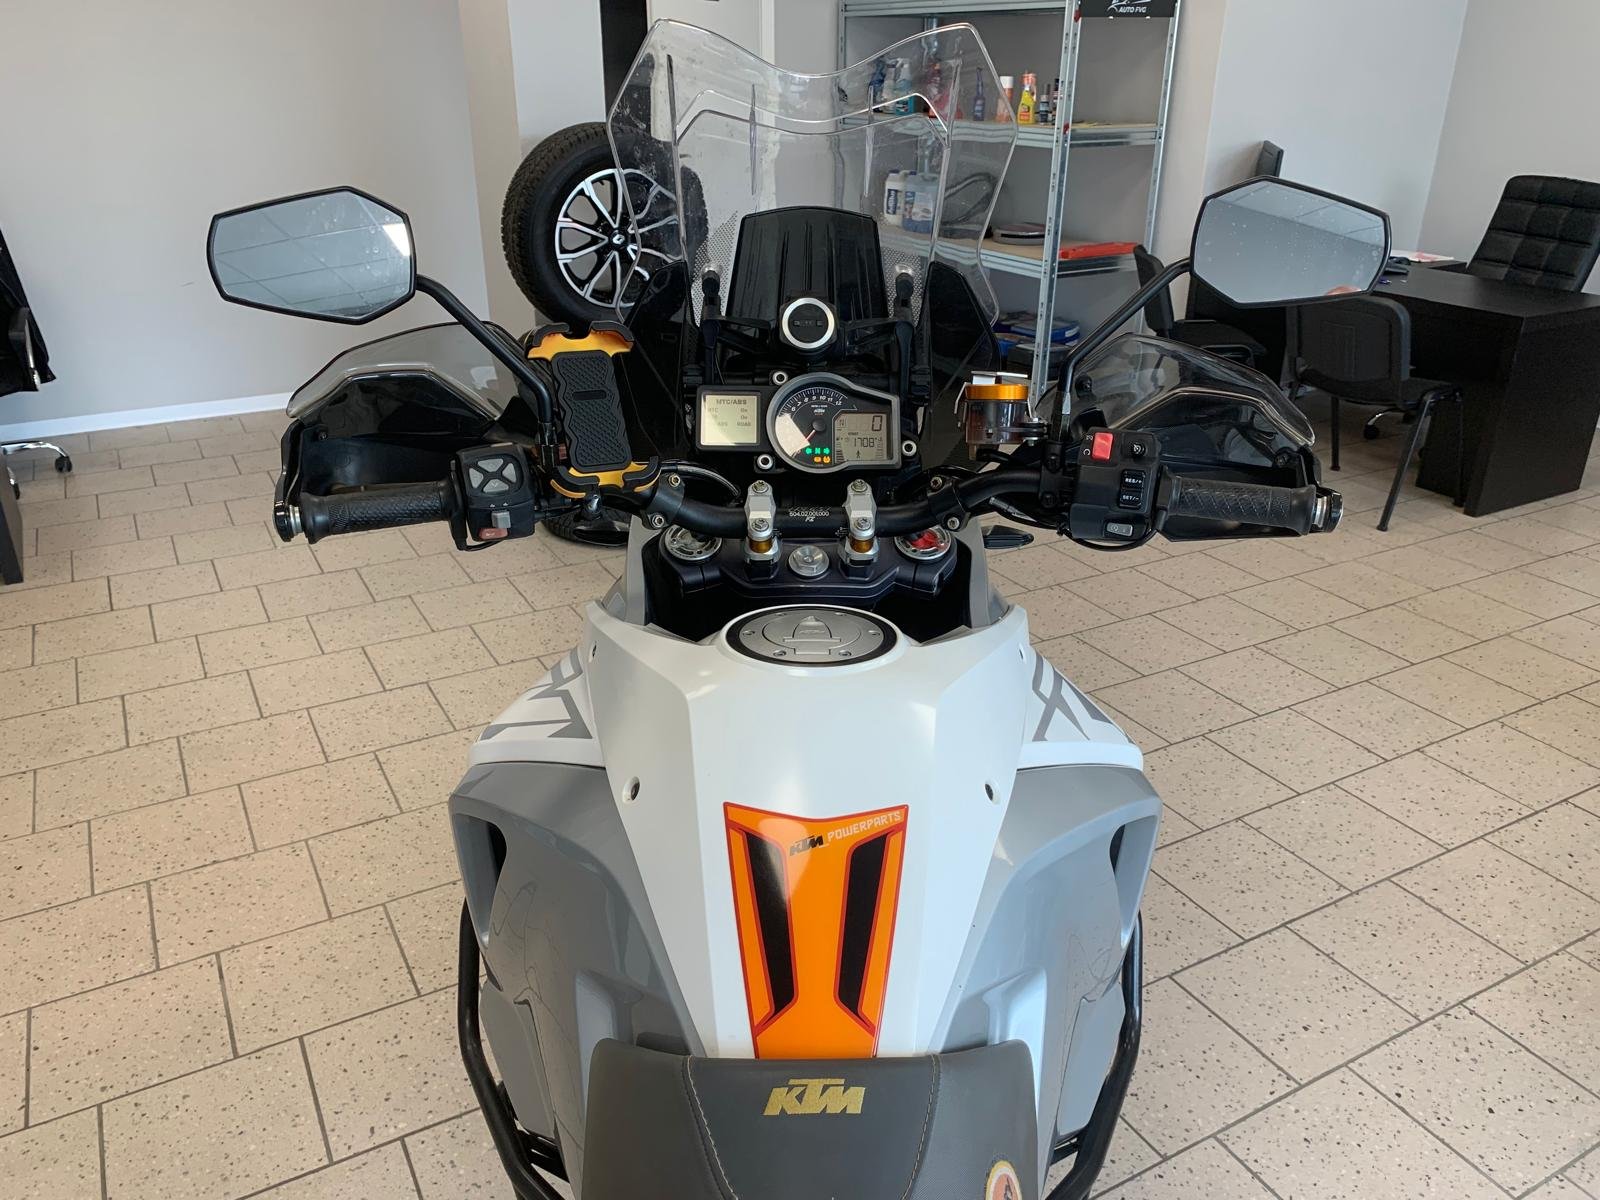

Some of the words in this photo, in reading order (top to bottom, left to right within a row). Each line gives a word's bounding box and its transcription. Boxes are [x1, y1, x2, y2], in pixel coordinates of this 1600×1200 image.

[872, 415, 882, 431] 0
[789, 835, 824, 857] KTM
[827, 811, 902, 842] POWERPARTS
[763, 1078, 866, 1116] KTM
